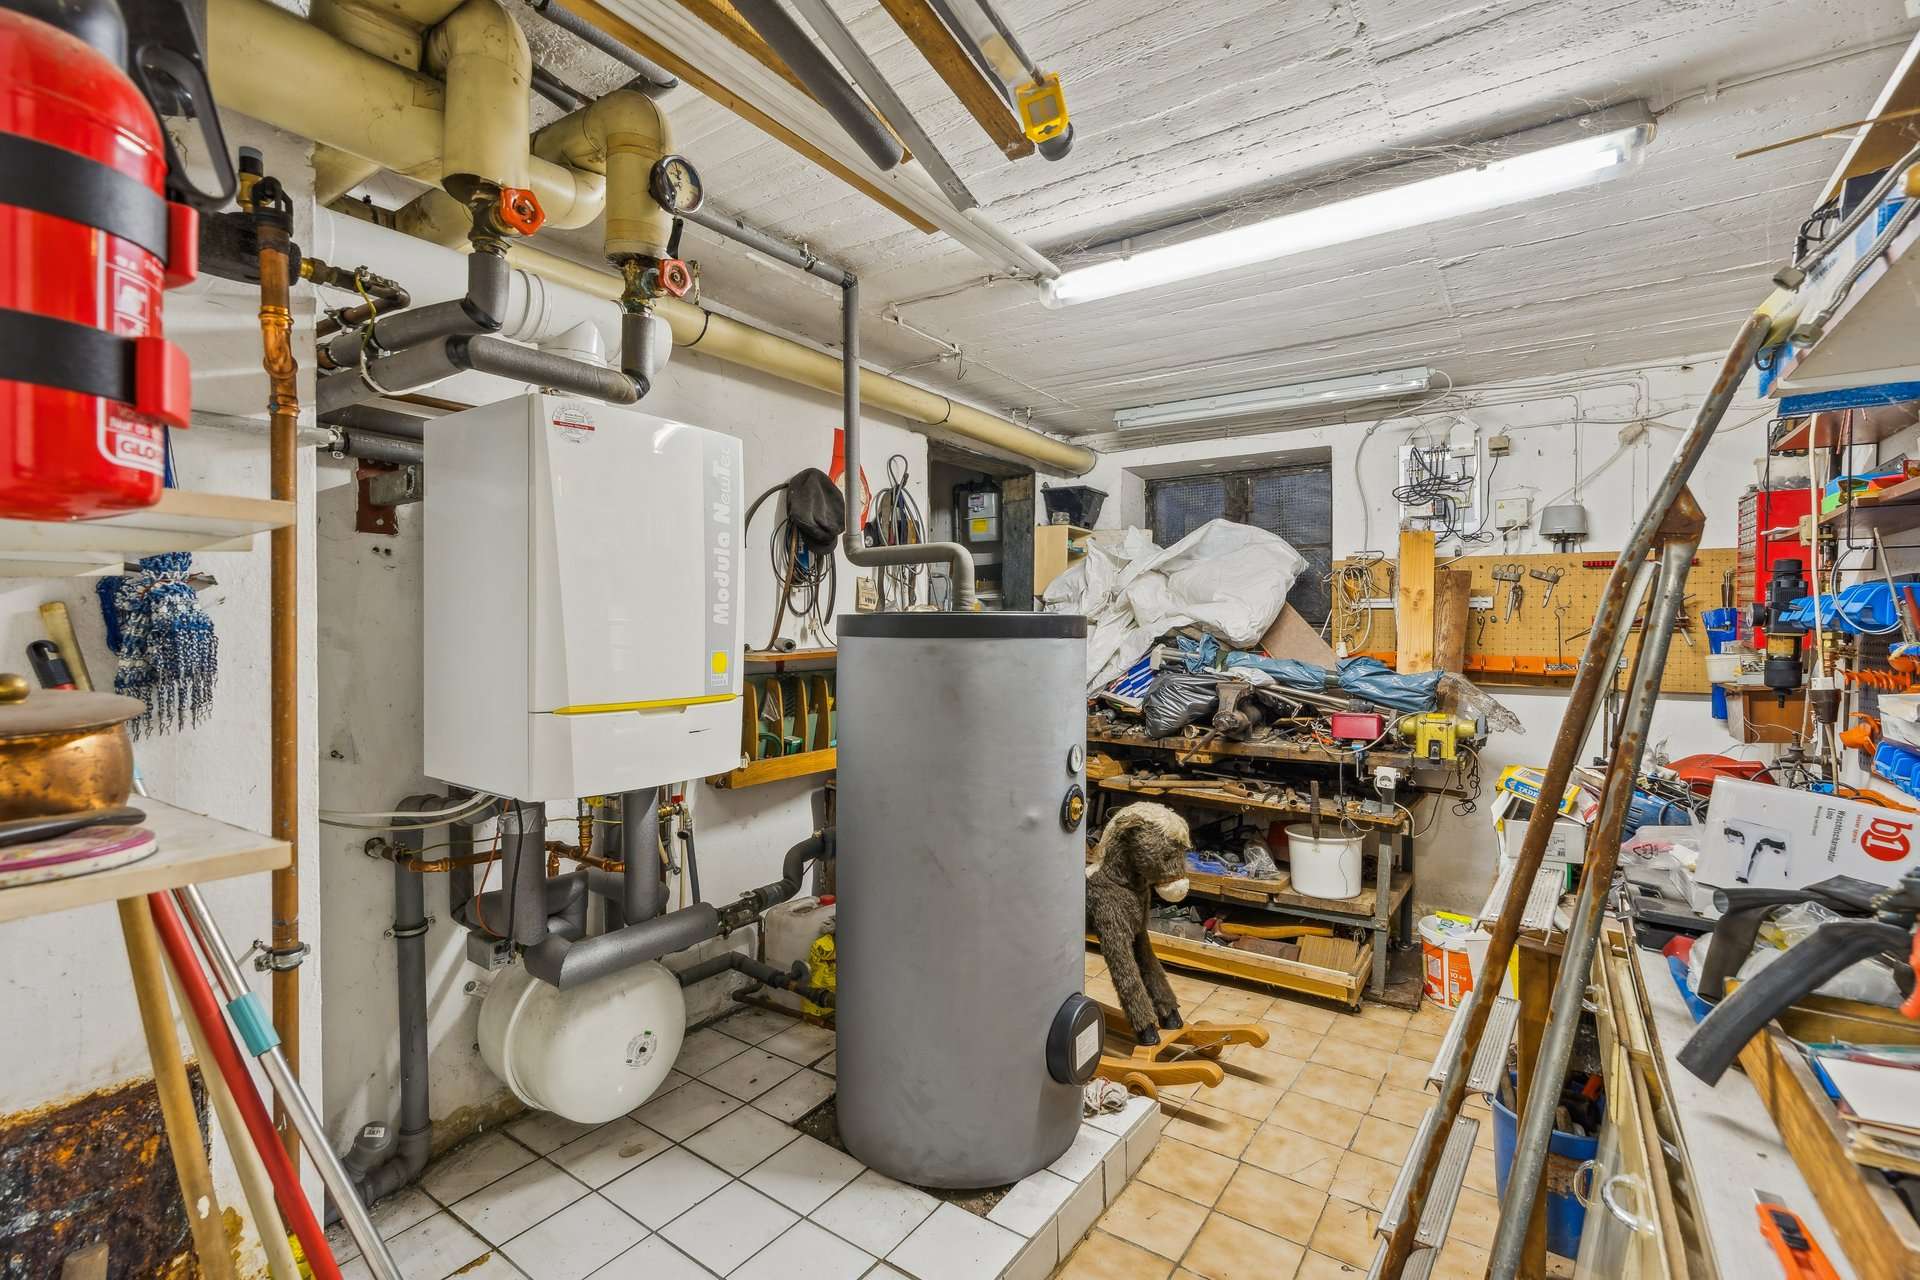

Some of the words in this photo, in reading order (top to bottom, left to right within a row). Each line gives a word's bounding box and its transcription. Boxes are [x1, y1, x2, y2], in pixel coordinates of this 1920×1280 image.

[713, 532, 730, 625] Modula
[1827, 810, 1846, 863] Waschtischarmatur
[1860, 817, 1913, 862] b1
